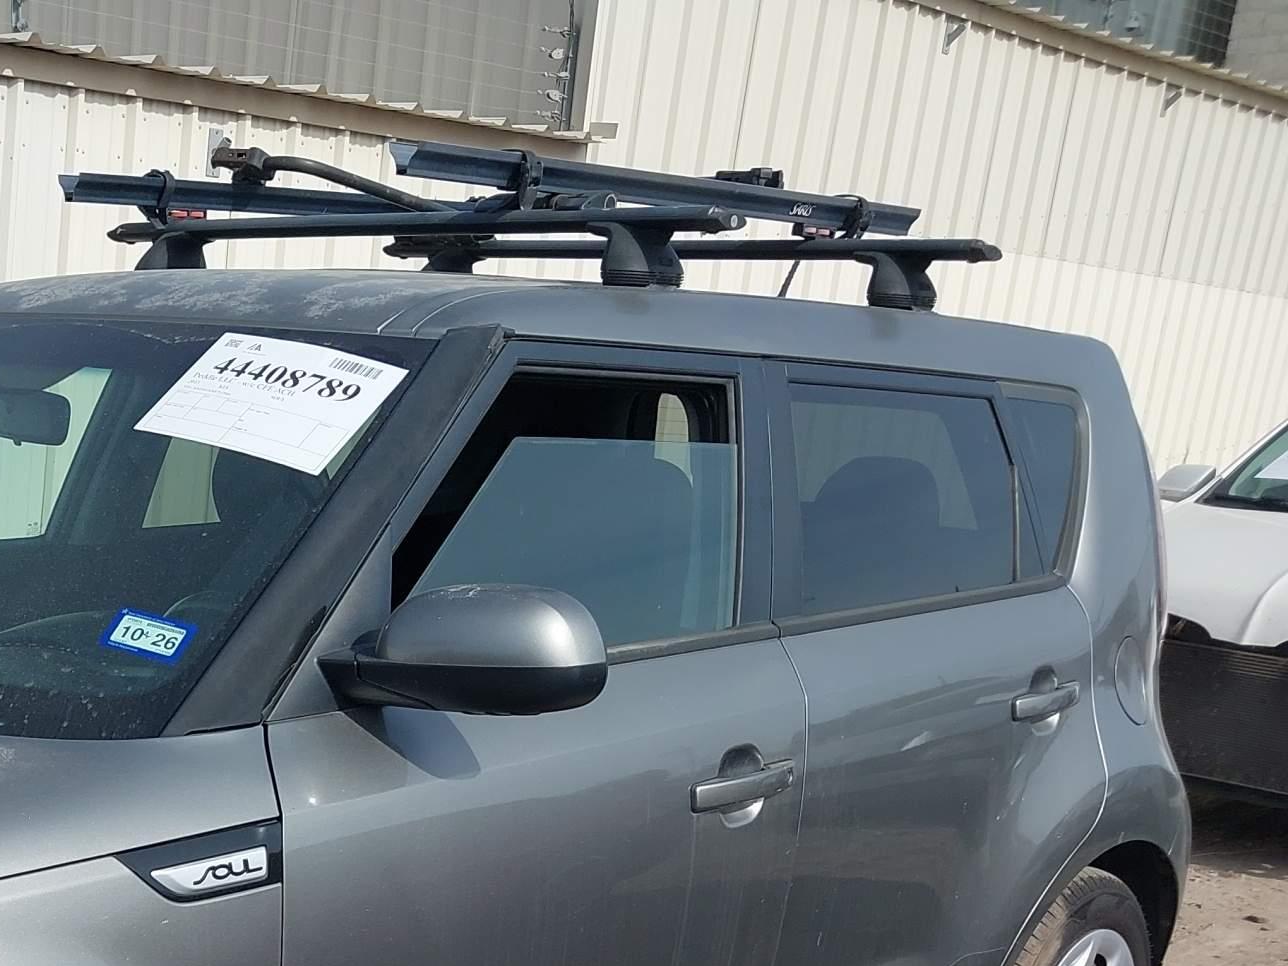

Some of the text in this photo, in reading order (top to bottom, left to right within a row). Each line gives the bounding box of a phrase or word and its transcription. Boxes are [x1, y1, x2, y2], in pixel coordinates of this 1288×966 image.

[213, 356, 361, 402] 44408789
[121, 625, 144, 641] 10
[150, 633, 179, 650] 26
[193, 858, 263, 886] SOUL
